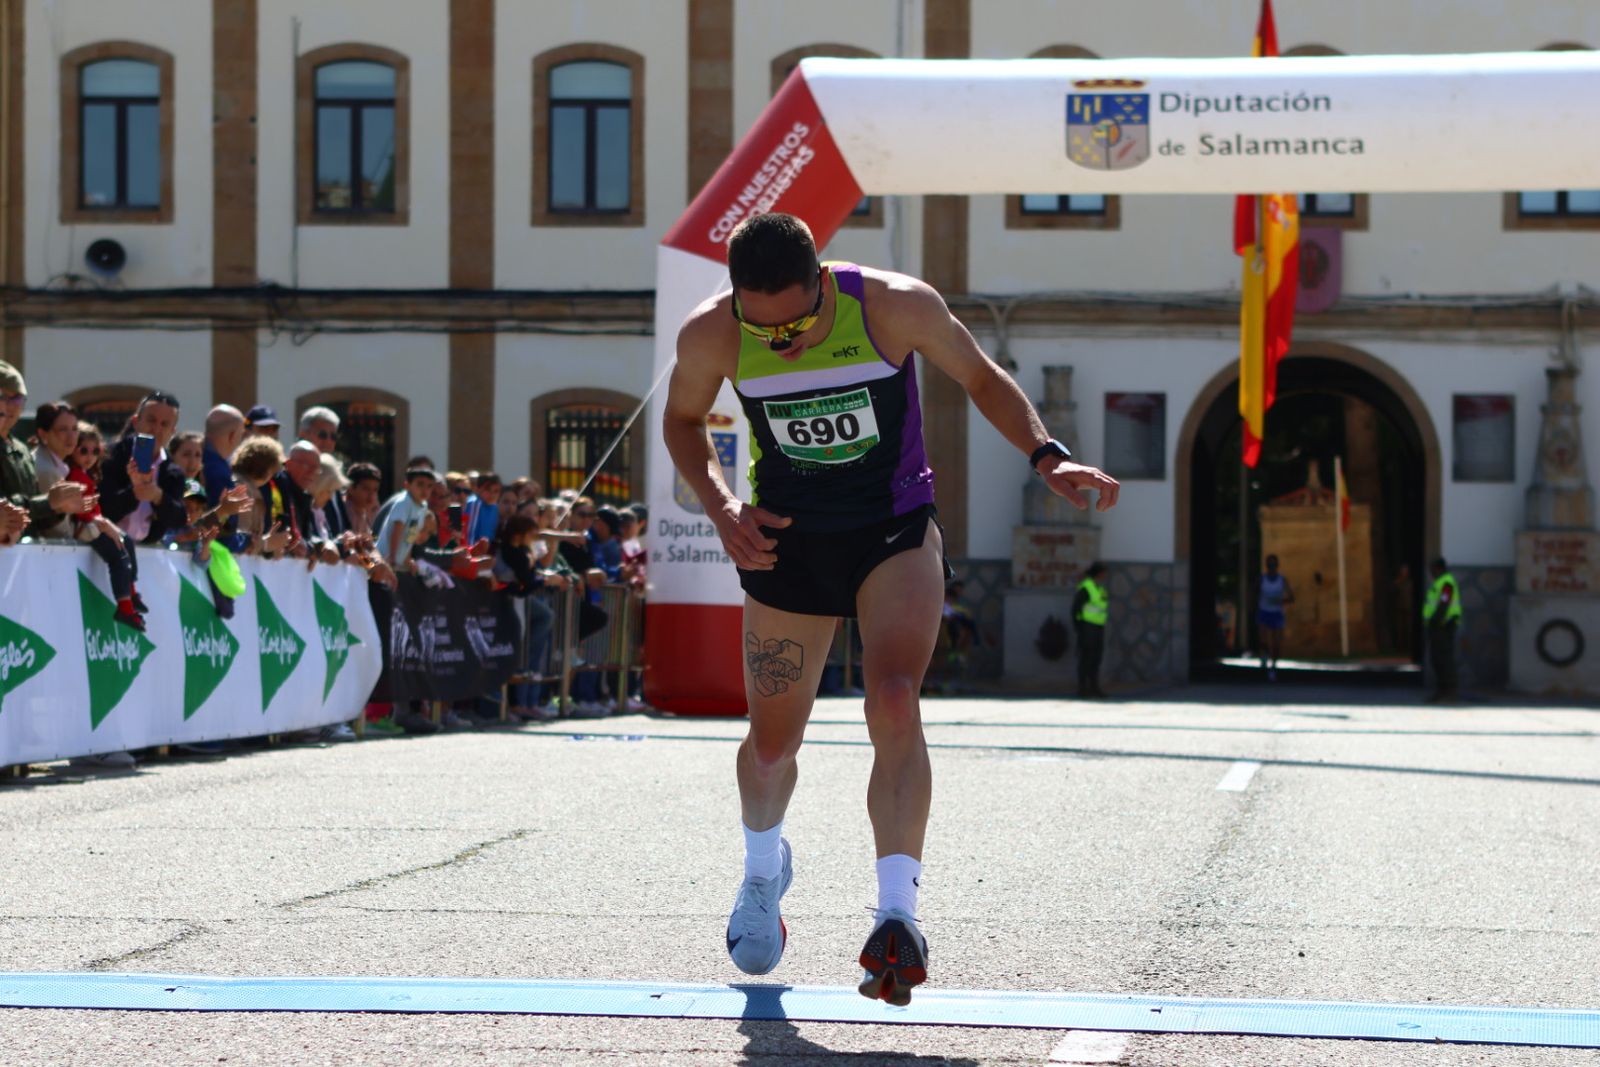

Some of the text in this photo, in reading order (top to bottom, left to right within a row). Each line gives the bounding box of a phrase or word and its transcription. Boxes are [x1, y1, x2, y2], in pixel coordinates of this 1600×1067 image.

[1159, 89, 1331, 117] Diputación
[1158, 133, 1366, 156] de Salamanca
[708, 121, 809, 244] CON NUESTROS
[794, 403, 843, 418] CARRERA
[786, 413, 860, 447] 690
[658, 517, 720, 541] Diputa
[667, 544, 730, 563] Salama
[0, 638, 36, 681] glés
